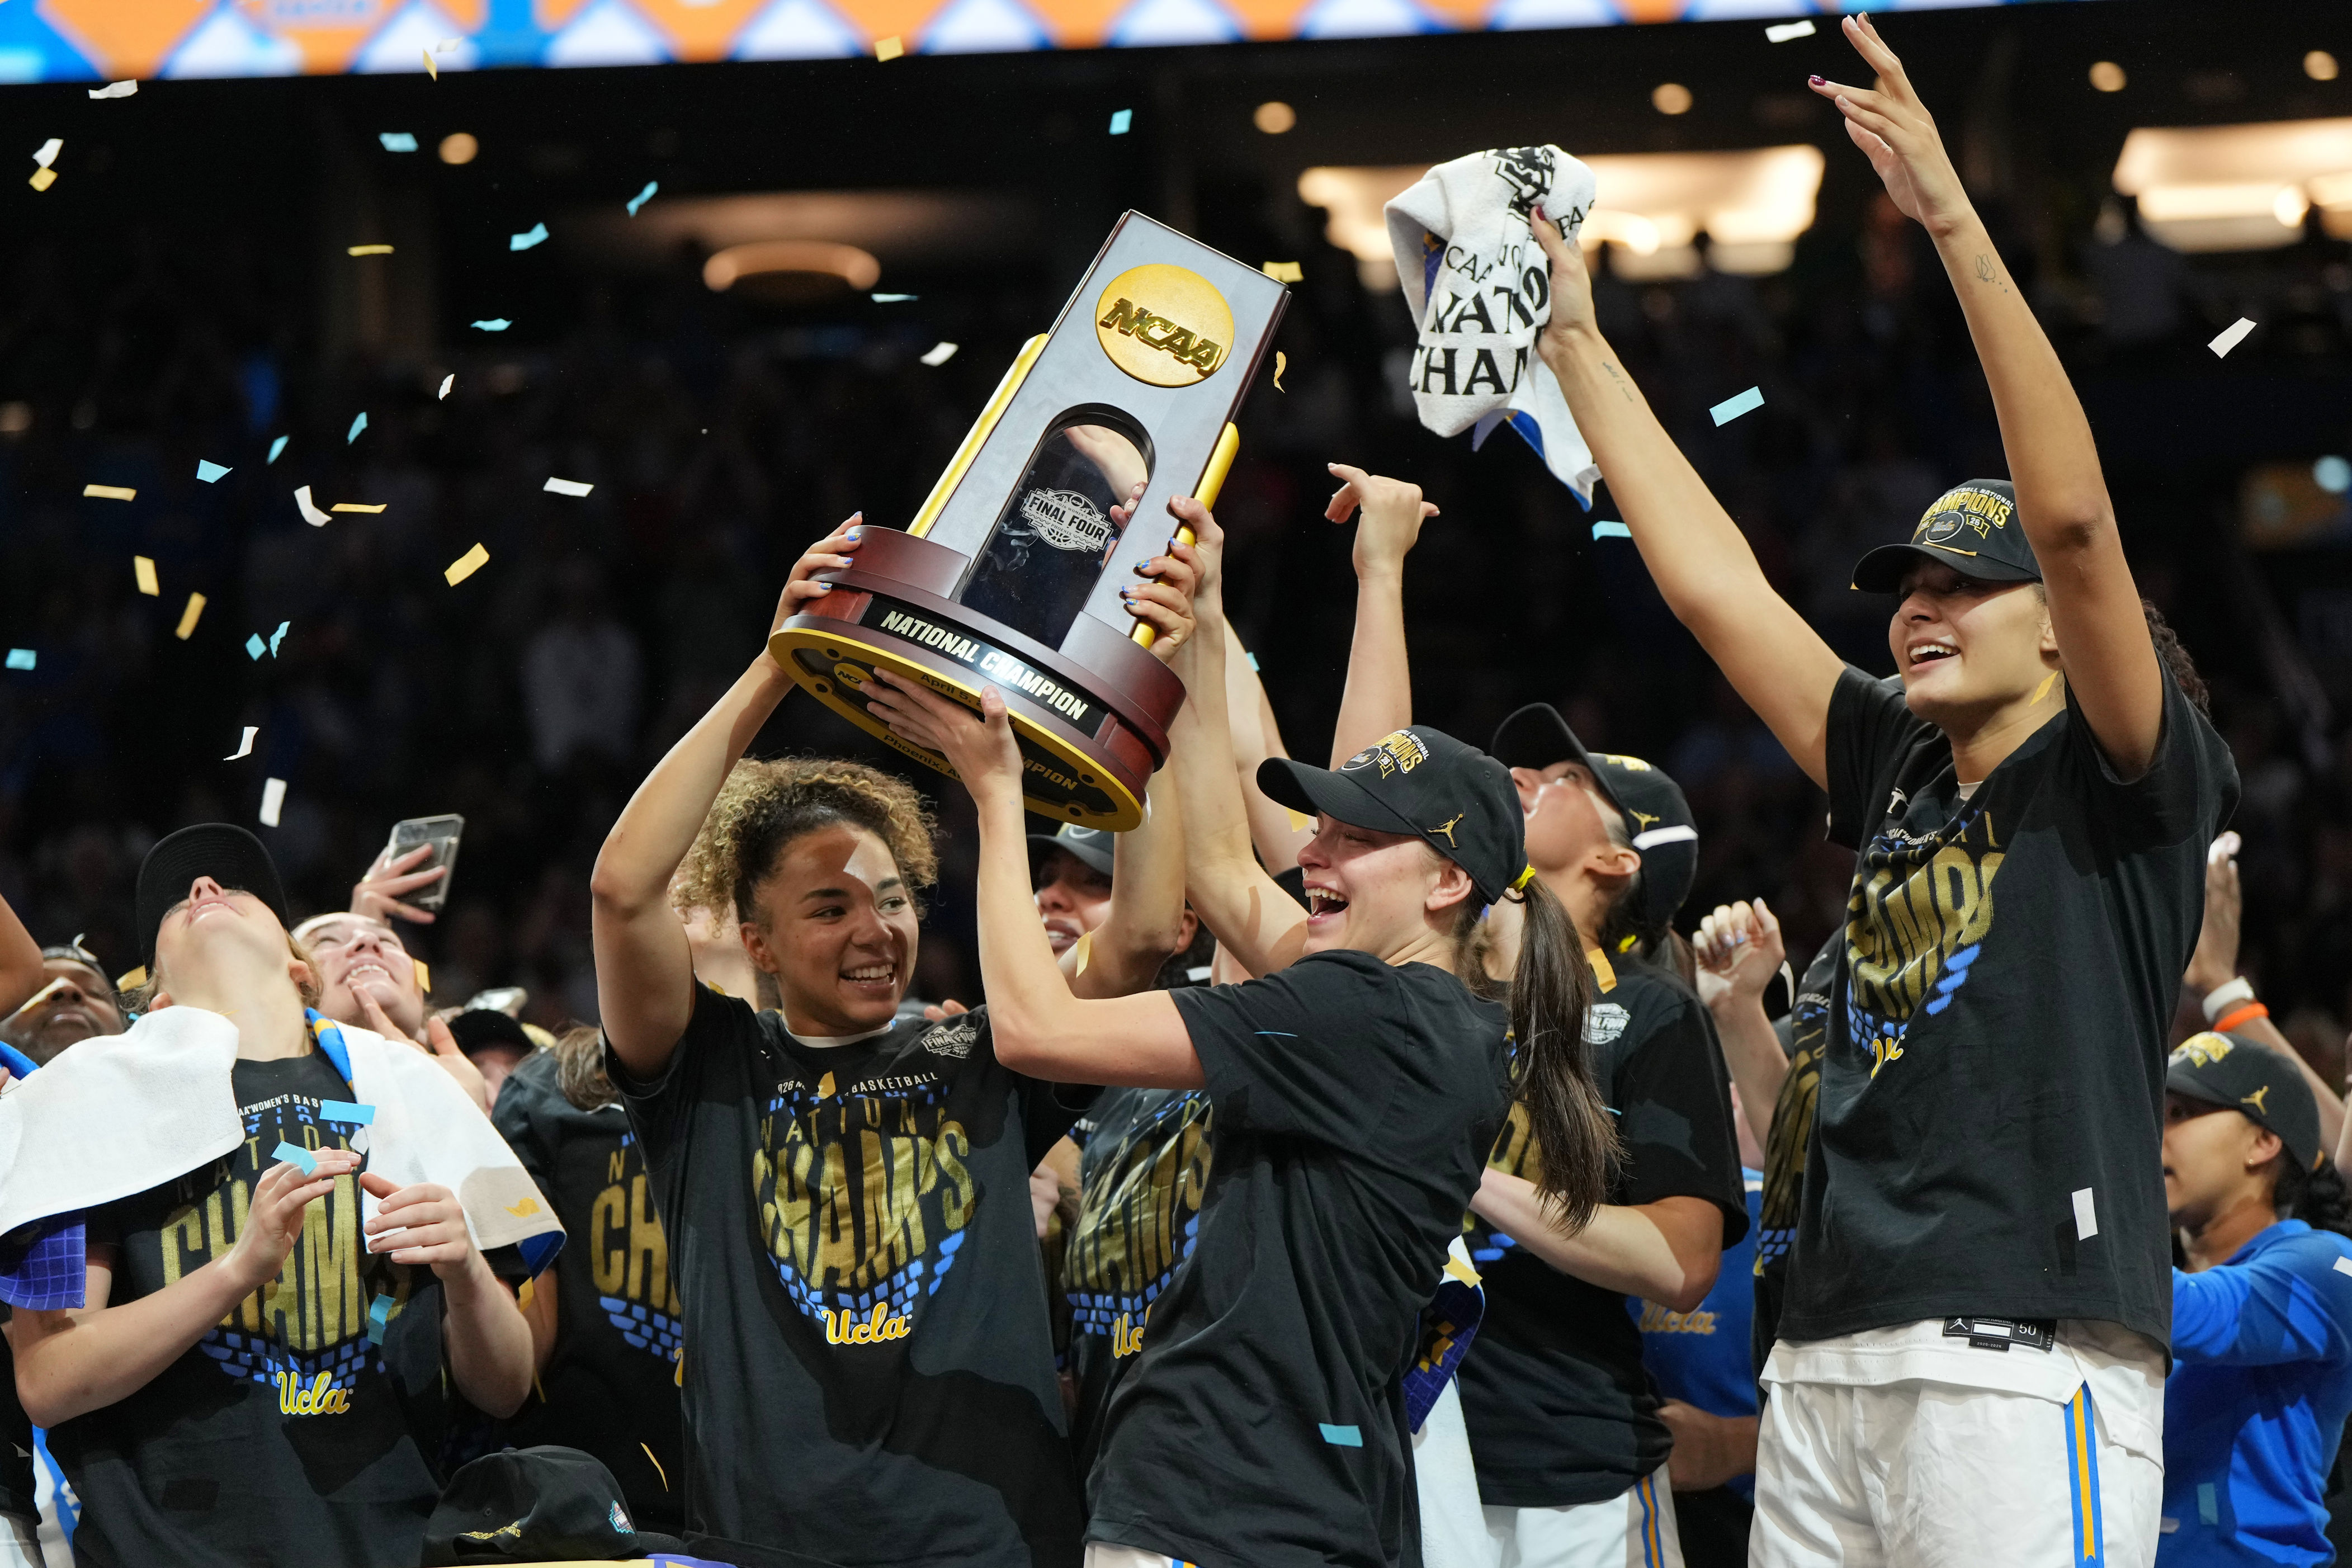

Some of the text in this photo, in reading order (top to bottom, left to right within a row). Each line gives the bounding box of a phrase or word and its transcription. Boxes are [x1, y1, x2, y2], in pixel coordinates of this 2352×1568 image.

[1099, 297, 1222, 377] NCAA
[1979, 488, 2014, 510] NATIONAL
[1029, 495, 1106, 541] FINAL FOUR
[1068, 507, 1088, 519] WOMEN'S
[1969, 517, 1981, 526] 26
[1051, 523, 1073, 536] PHOENIX
[880, 611, 981, 667] NATIONAL
[980, 651, 1089, 721] CHAMPION
[837, 670, 862, 685] NCA
[920, 673, 956, 694] April
[883, 734, 943, 771] Phoenix,
[925, 1035, 952, 1048] FINA
[852, 1072, 939, 1093] BASKETBALL
[251, 1094, 289, 1113] WOMEN'S
[2019, 1323, 2037, 1336] 50
